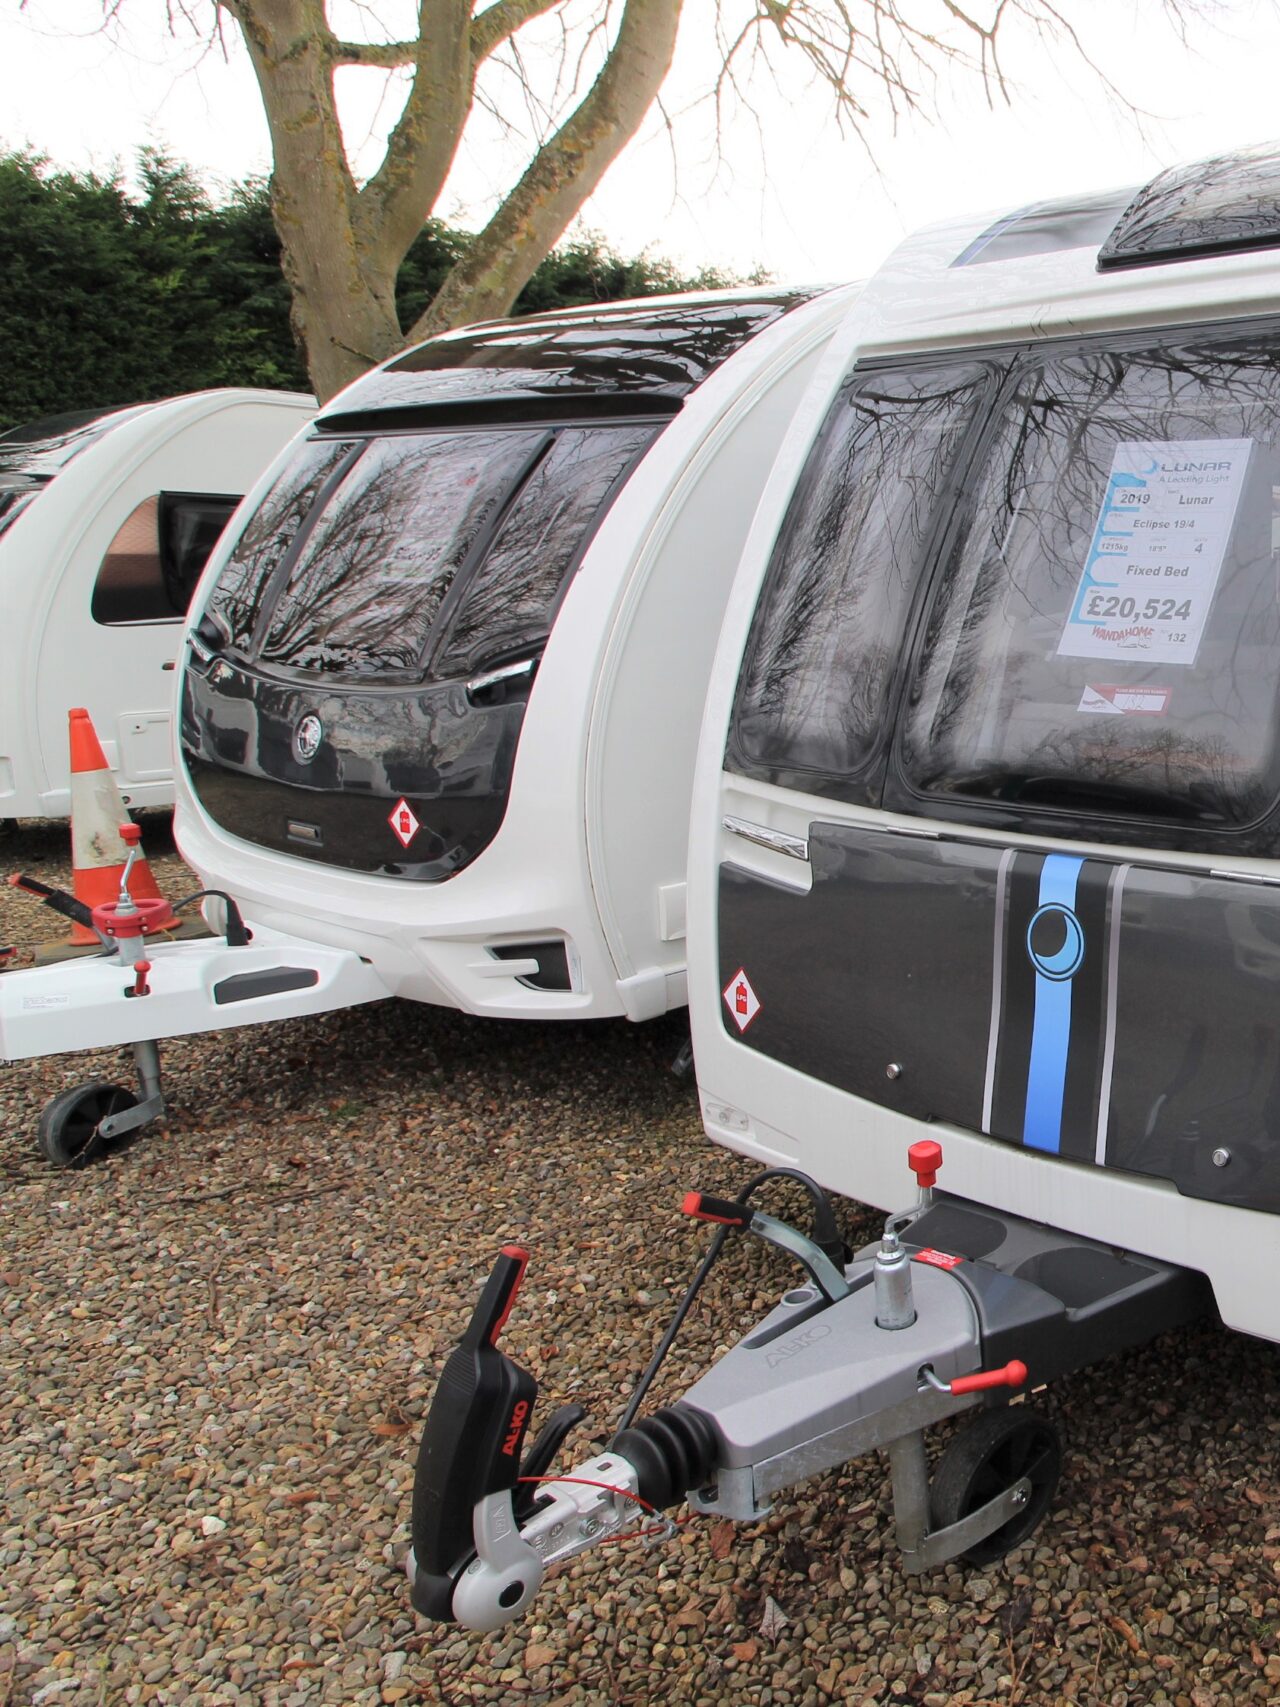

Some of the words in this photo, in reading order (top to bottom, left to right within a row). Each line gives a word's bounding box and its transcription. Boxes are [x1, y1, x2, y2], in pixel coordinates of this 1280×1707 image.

[1160, 461, 1232, 472] LUNAR
[1120, 493, 1151, 504] 2019
[1178, 494, 1214, 505] Lunar
[1133, 519, 1170, 530] Eclipse
[1173, 519, 1195, 529] 19/4
[1194, 543, 1203, 554] 4
[1126, 564, 1162, 577] Fixed
[1164, 565, 1190, 578] Bed
[1086, 594, 1193, 623] £20,524
[1092, 624, 1155, 641] WANDAHOME
[1167, 632, 1187, 643] 132
[502, 1400, 529, 1457] AL-KO
